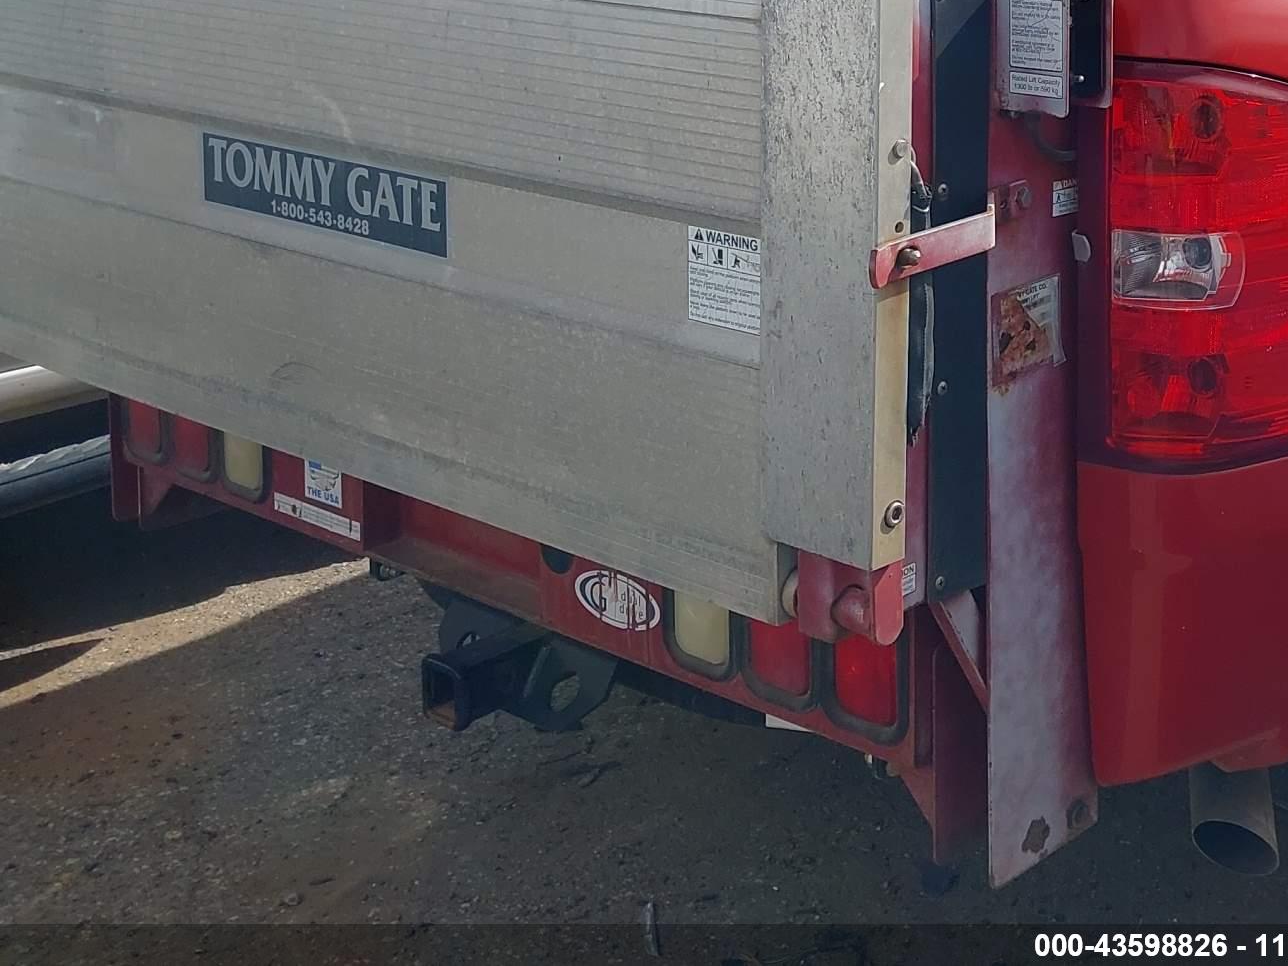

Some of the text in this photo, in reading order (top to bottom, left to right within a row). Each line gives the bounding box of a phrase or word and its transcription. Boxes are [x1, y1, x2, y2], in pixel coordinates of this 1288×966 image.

[208, 137, 441, 232] TOMMY GATE
[270, 199, 370, 236] 1-800-543-8428
[706, 230, 758, 251] WARNING
[308, 486, 340, 505] THE USA
